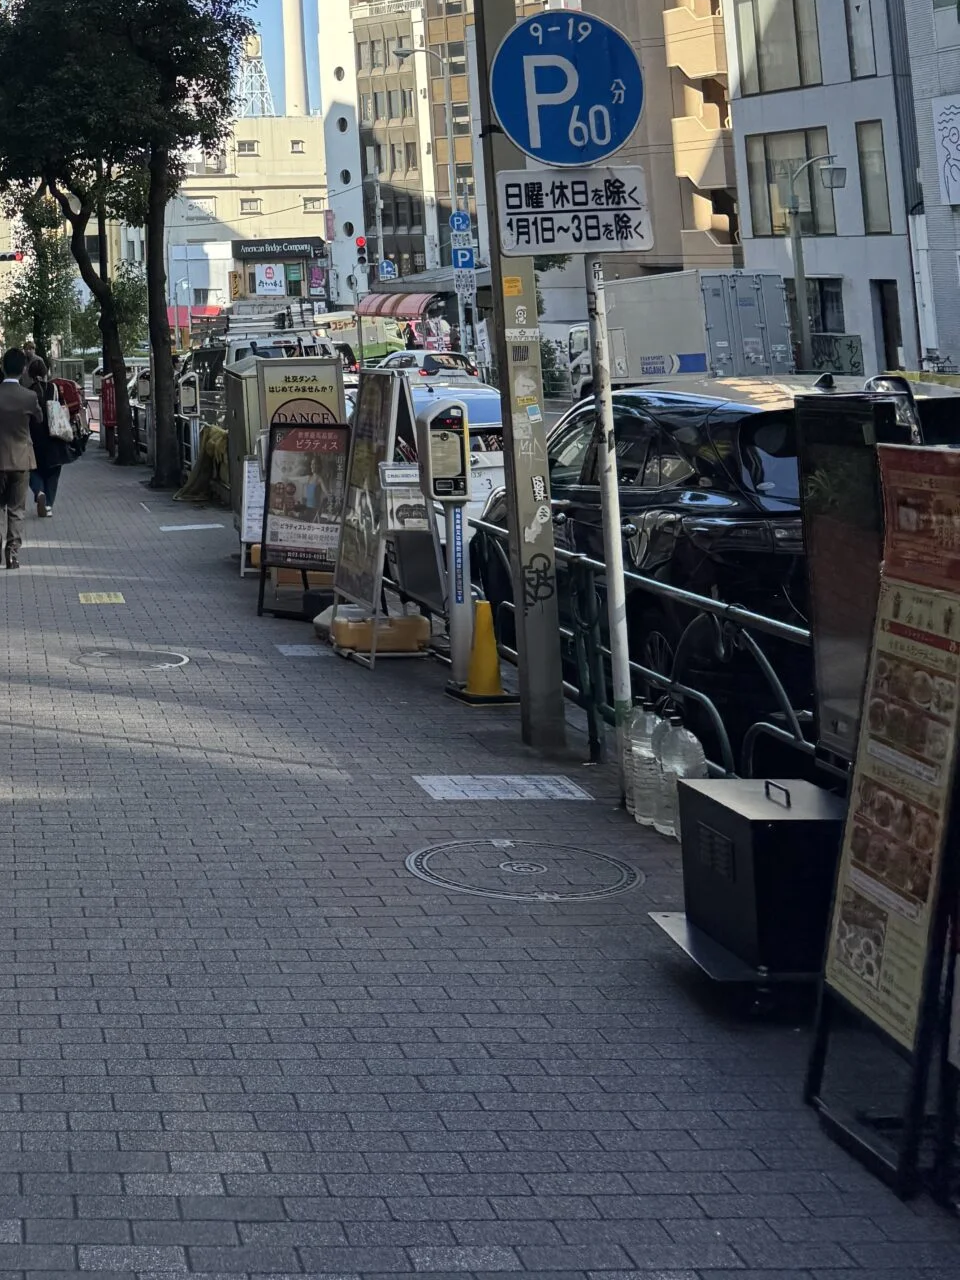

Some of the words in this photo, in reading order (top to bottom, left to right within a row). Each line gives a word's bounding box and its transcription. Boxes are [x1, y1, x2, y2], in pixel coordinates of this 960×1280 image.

[529, 18, 592, 45] 9-19
[610, 78, 627, 104] 分
[523, 55, 579, 149] P
[568, 104, 611, 147] 60
[505, 179, 641, 209] 日曜・休日を除く
[454, 217, 462, 229] P
[240, 245, 265, 253] American
[282, 242, 311, 253] Company
[457, 250, 470, 267] P
[268, 385, 334, 393] はじめてみませんか？
[277, 412, 330, 424] DANCE
[296, 440, 338, 450] ピラティス
